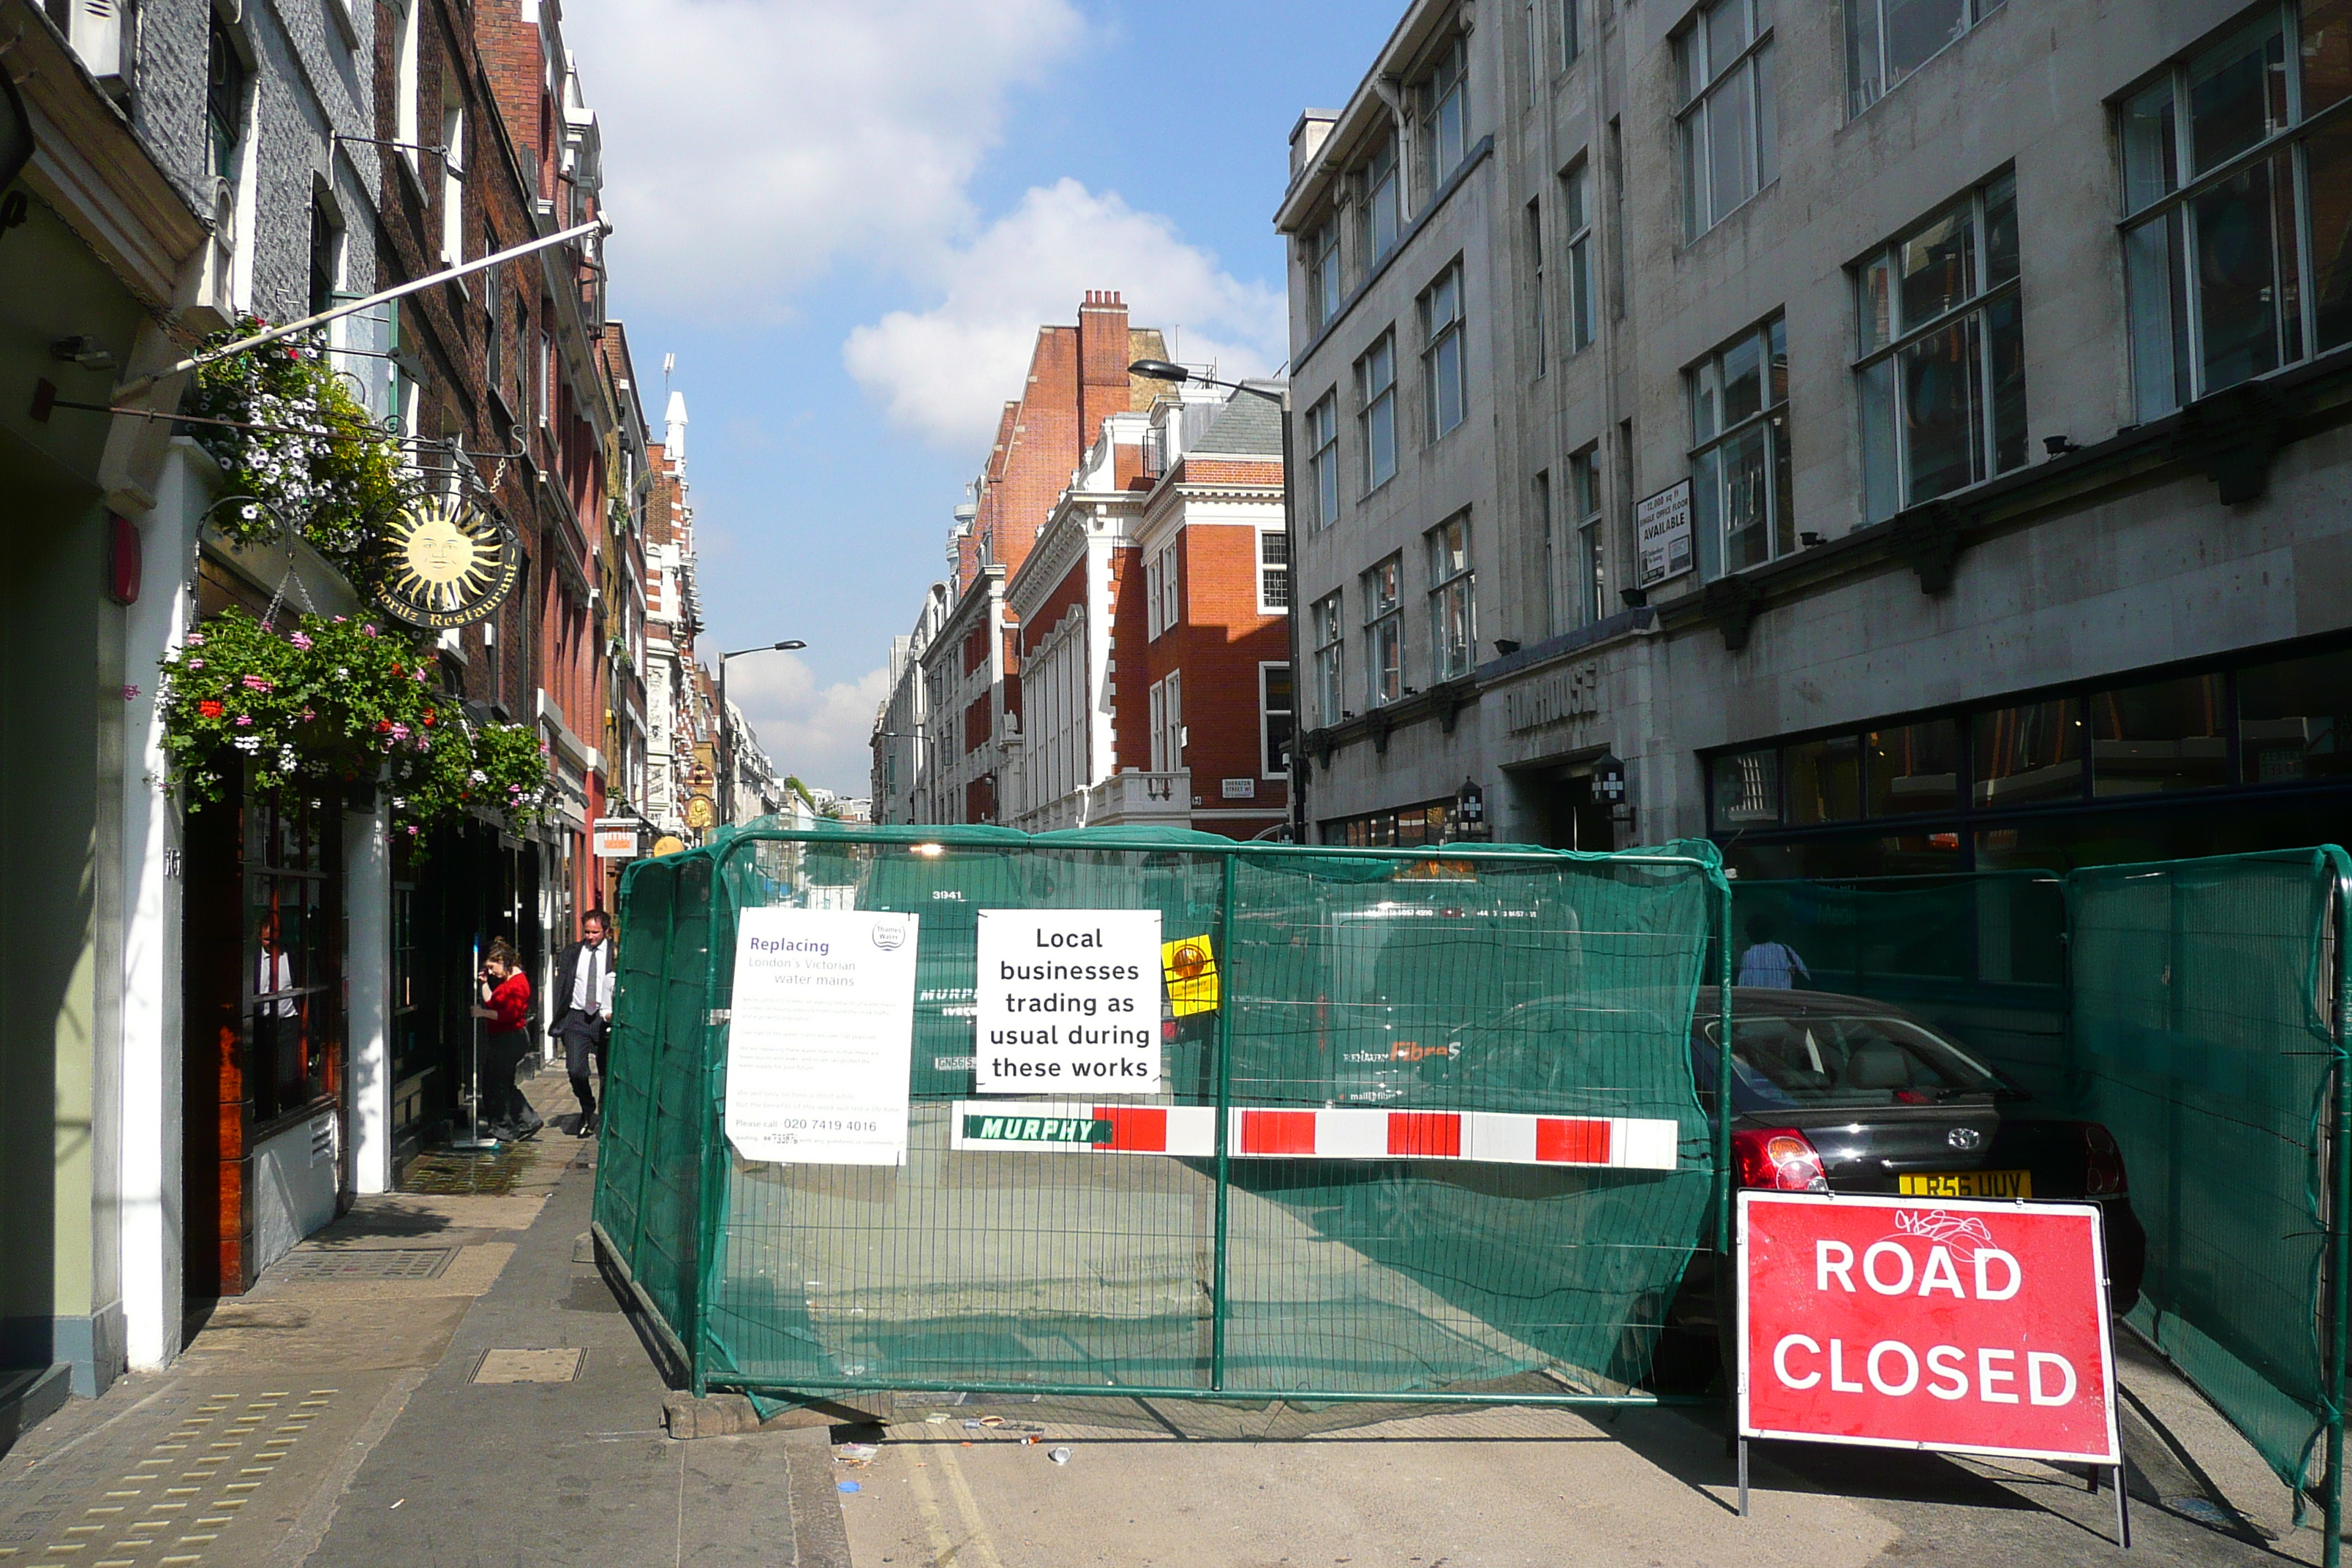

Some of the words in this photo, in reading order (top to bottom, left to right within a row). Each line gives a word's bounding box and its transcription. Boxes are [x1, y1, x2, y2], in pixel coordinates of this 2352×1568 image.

[1656, 506, 1671, 519] OFFICE
[1673, 499, 1688, 512] FLOOR
[1644, 513, 1684, 542] AVAILABLE
[429, 564, 517, 627] Restaurant
[1540, 664, 1597, 723] HOUSE
[932, 891, 962, 899] 3941
[750, 937, 829, 957] Replacing
[1036, 928, 1103, 948] Local
[749, 957, 800, 968] London's
[805, 960, 856, 970] Victorian
[1000, 960, 1139, 980] businesses
[774, 974, 812, 984] water
[816, 975, 854, 987] mains
[1006, 993, 1097, 1016] trading
[1108, 996, 1134, 1012] as
[990, 1025, 1058, 1045] usual
[1068, 1026, 1150, 1048] during
[939, 1058, 964, 1067] GN56
[967, 1058, 976, 1067] S
[992, 1058, 1061, 1077] these
[1072, 1058, 1148, 1077] works
[736, 1119, 761, 1128] Please
[764, 1120, 777, 1128] call
[784, 1119, 807, 1129] 020
[812, 1120, 842, 1131] 7419
[846, 1121, 877, 1132] 4016
[981, 1117, 1094, 1142] MURPHY
[1816, 1239, 2022, 1302] ROAD
[1772, 1333, 2078, 1408] CLOSED
